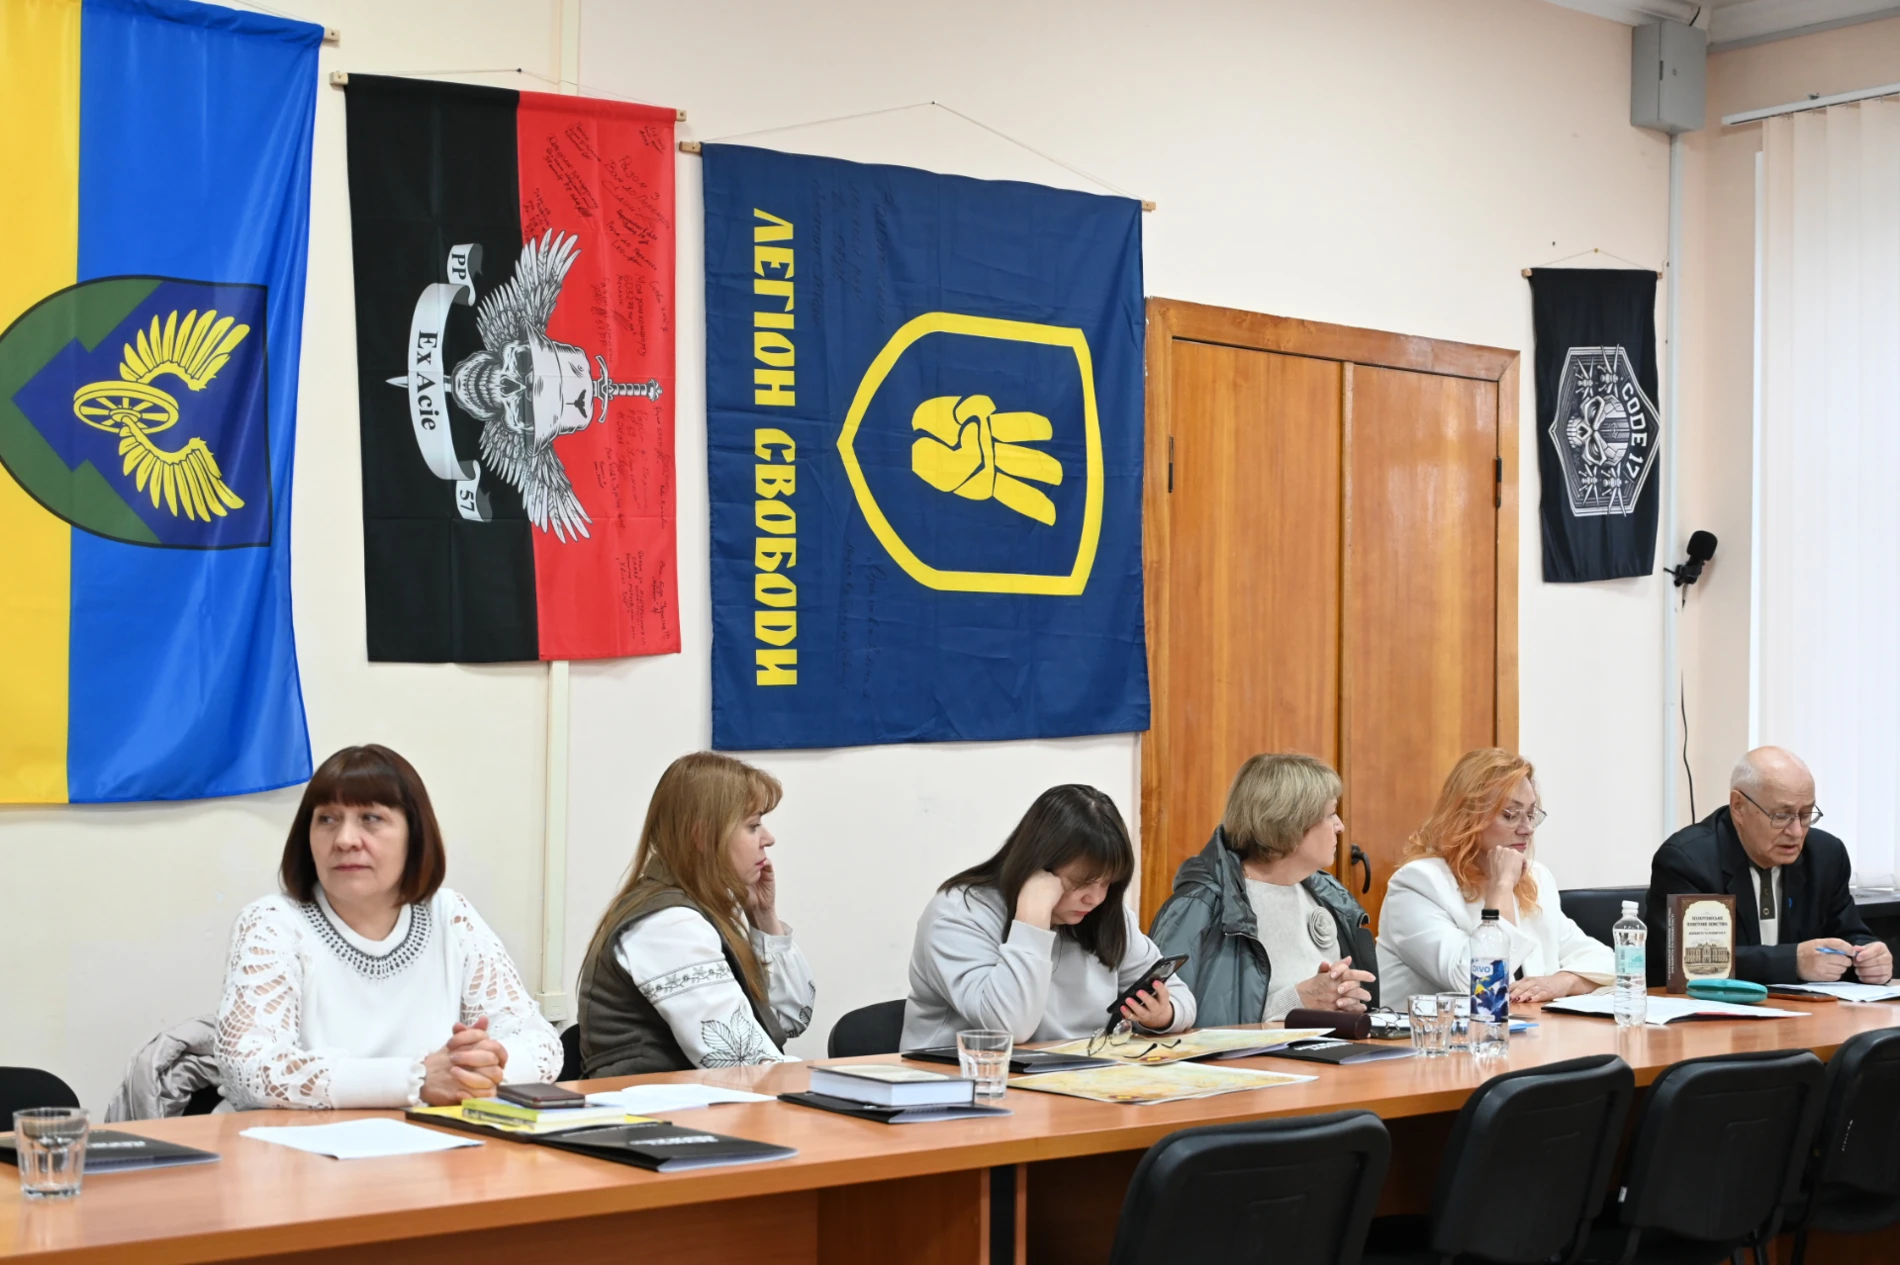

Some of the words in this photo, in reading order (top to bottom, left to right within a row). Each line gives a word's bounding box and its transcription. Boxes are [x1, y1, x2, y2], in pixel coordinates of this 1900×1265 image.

[753, 208, 796, 407] ЛЕГІОН
[416, 330, 438, 365] Ex
[416, 371, 440, 431] Acie
[1621, 382, 1648, 447] CODE
[1626, 453, 1645, 479] 17
[459, 488, 476, 512] 57
[754, 428, 798, 686] СВОБОДИ
